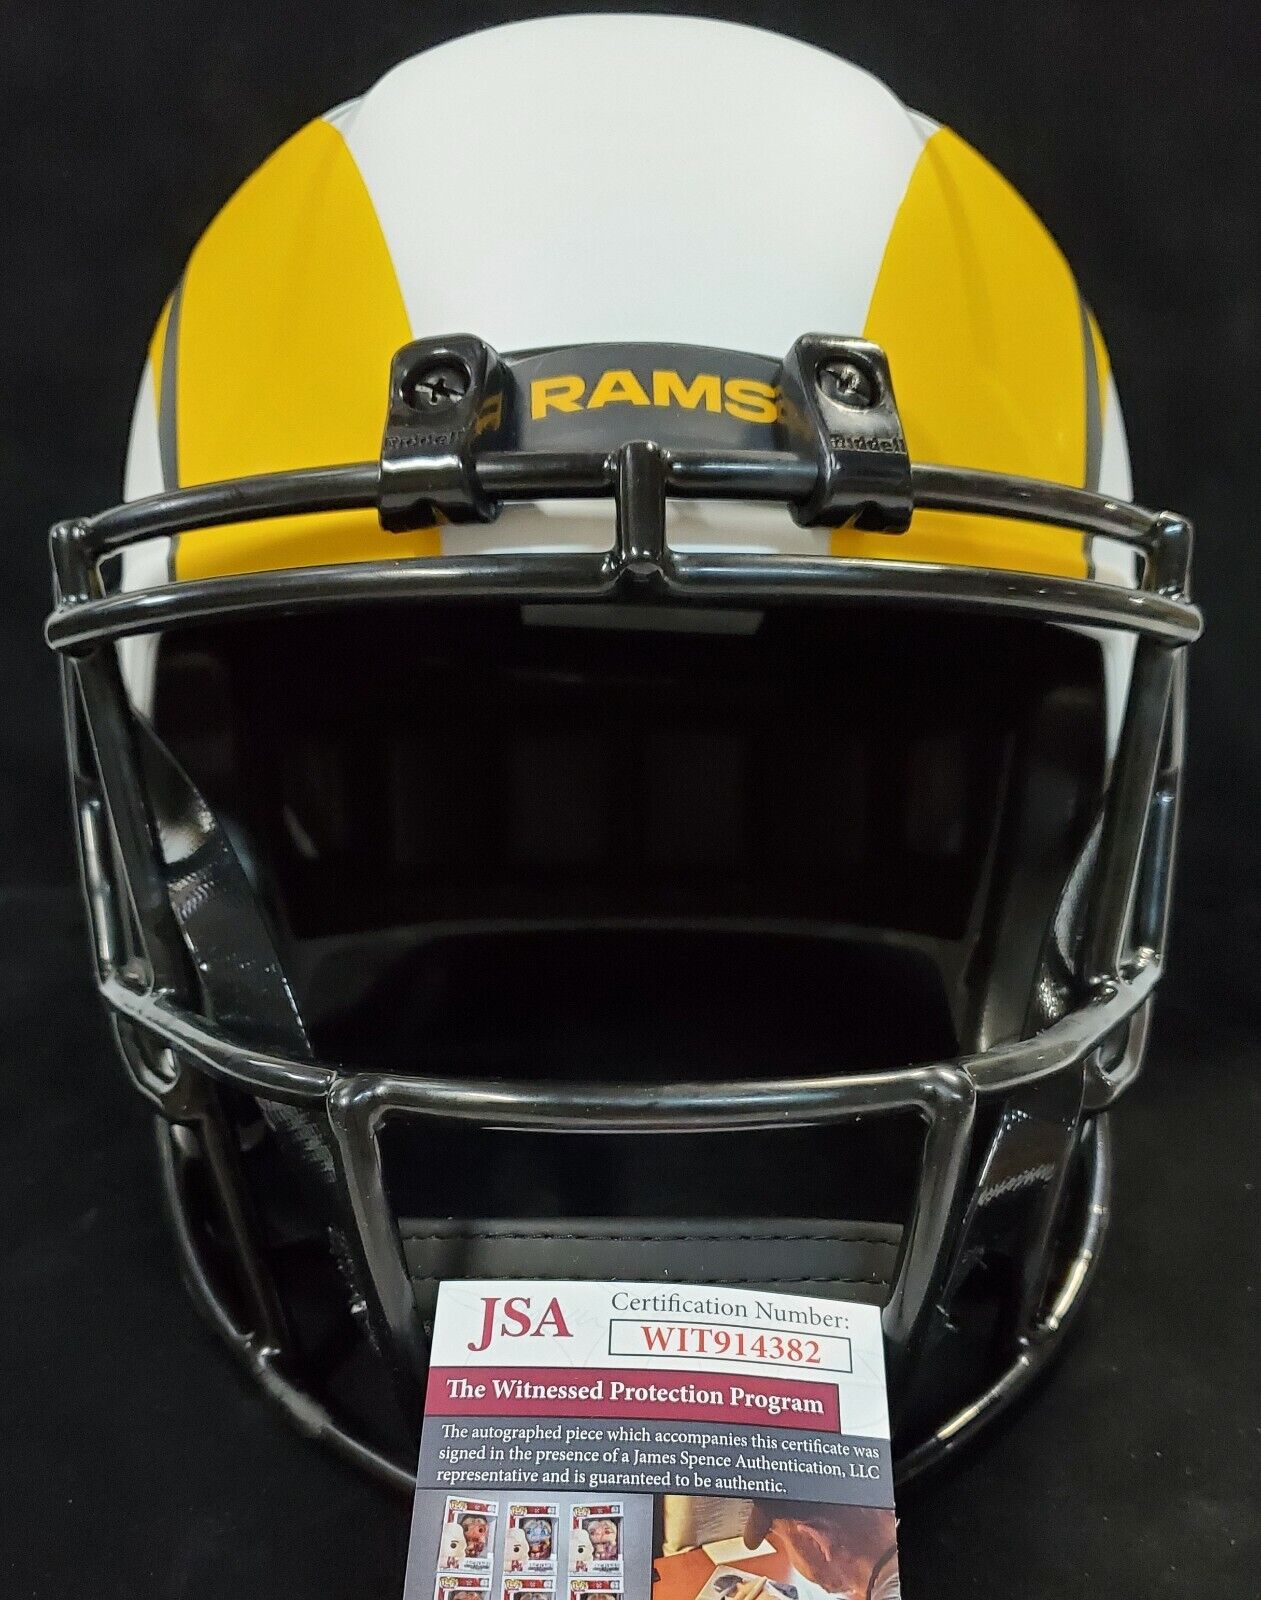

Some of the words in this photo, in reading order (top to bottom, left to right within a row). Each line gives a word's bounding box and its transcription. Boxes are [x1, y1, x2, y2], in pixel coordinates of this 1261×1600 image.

[531, 368, 779, 424] RAMS
[467, 1297, 574, 1352] JSA
[611, 1292, 747, 1318] Certification
[755, 1300, 850, 1330] Number:
[641, 1326, 821, 1364] WIT914382
[446, 1379, 486, 1399] The
[492, 1379, 603, 1400] Witnessed
[610, 1381, 724, 1405] Protection
[730, 1387, 824, 1415] Program
[442, 1424, 468, 1439] The
[472, 1425, 562, 1443] autographed
[566, 1427, 603, 1443] piece
[607, 1427, 651, 1441] which
[655, 1431, 748, 1449] accompanies
[751, 1434, 778, 1449] this
[781, 1439, 850, 1456] certificate
[853, 1447, 880, 1459] was
[437, 1469, 539, 1485] representative
[542, 1468, 569, 1483] and
[574, 1469, 585, 1483] is
[589, 1471, 671, 1487] guaranteed
[675, 1473, 690, 1487] to
[694, 1473, 711, 1488] be
[715, 1475, 787, 1493] authentic.
[439, 1446, 486, 1463] signed
[490, 1447, 504, 1460] in
[509, 1446, 532, 1460] the
[536, 1450, 599, 1464] presence
[603, 1448, 620, 1462] of
[622, 1453, 630, 1463] a
[633, 1450, 676, 1465] James
[680, 1451, 731, 1469] Spence
[735, 1454, 846, 1478] Authentication,
[849, 1463, 880, 1480] LLC
